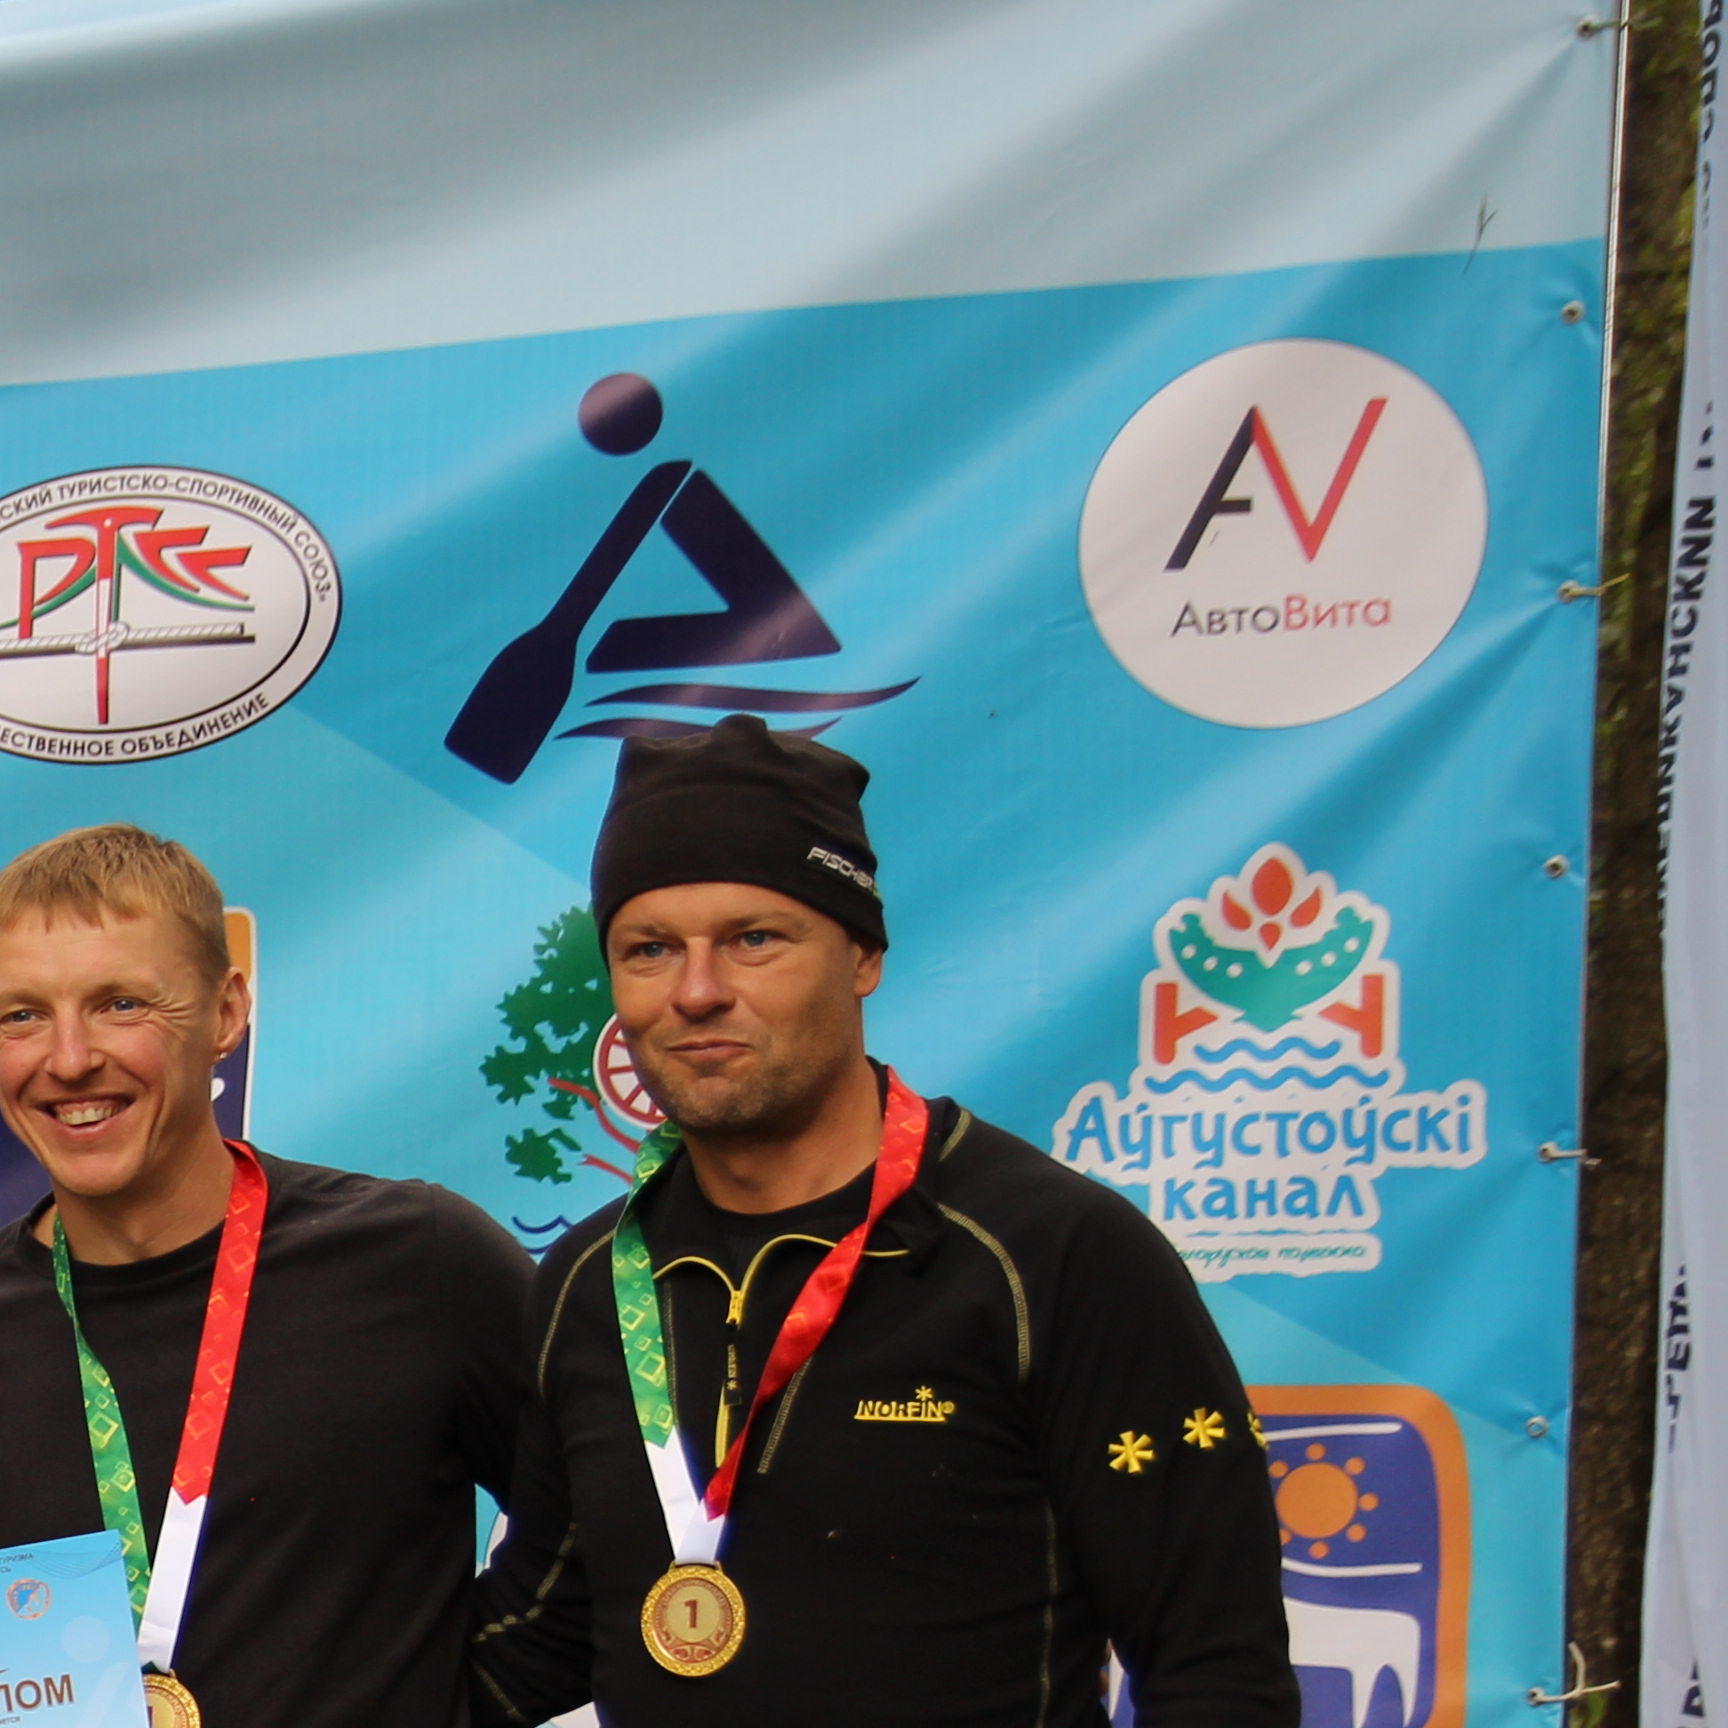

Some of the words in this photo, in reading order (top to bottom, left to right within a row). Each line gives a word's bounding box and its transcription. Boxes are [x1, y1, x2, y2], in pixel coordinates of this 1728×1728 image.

[56, 473, 302, 538] ТУРИСТСКО-СПОРТИВНЫЙ
[1170, 594, 1393, 639] АвтоВита
[120, 691, 271, 755] ОБЪЕДИНЕНИЕ
[806, 846, 874, 891] FISCHER
[1065, 1094, 1471, 1172] Аўгустоўскі
[1161, 1173, 1365, 1222] канал
[684, 1599, 697, 1628] 1
